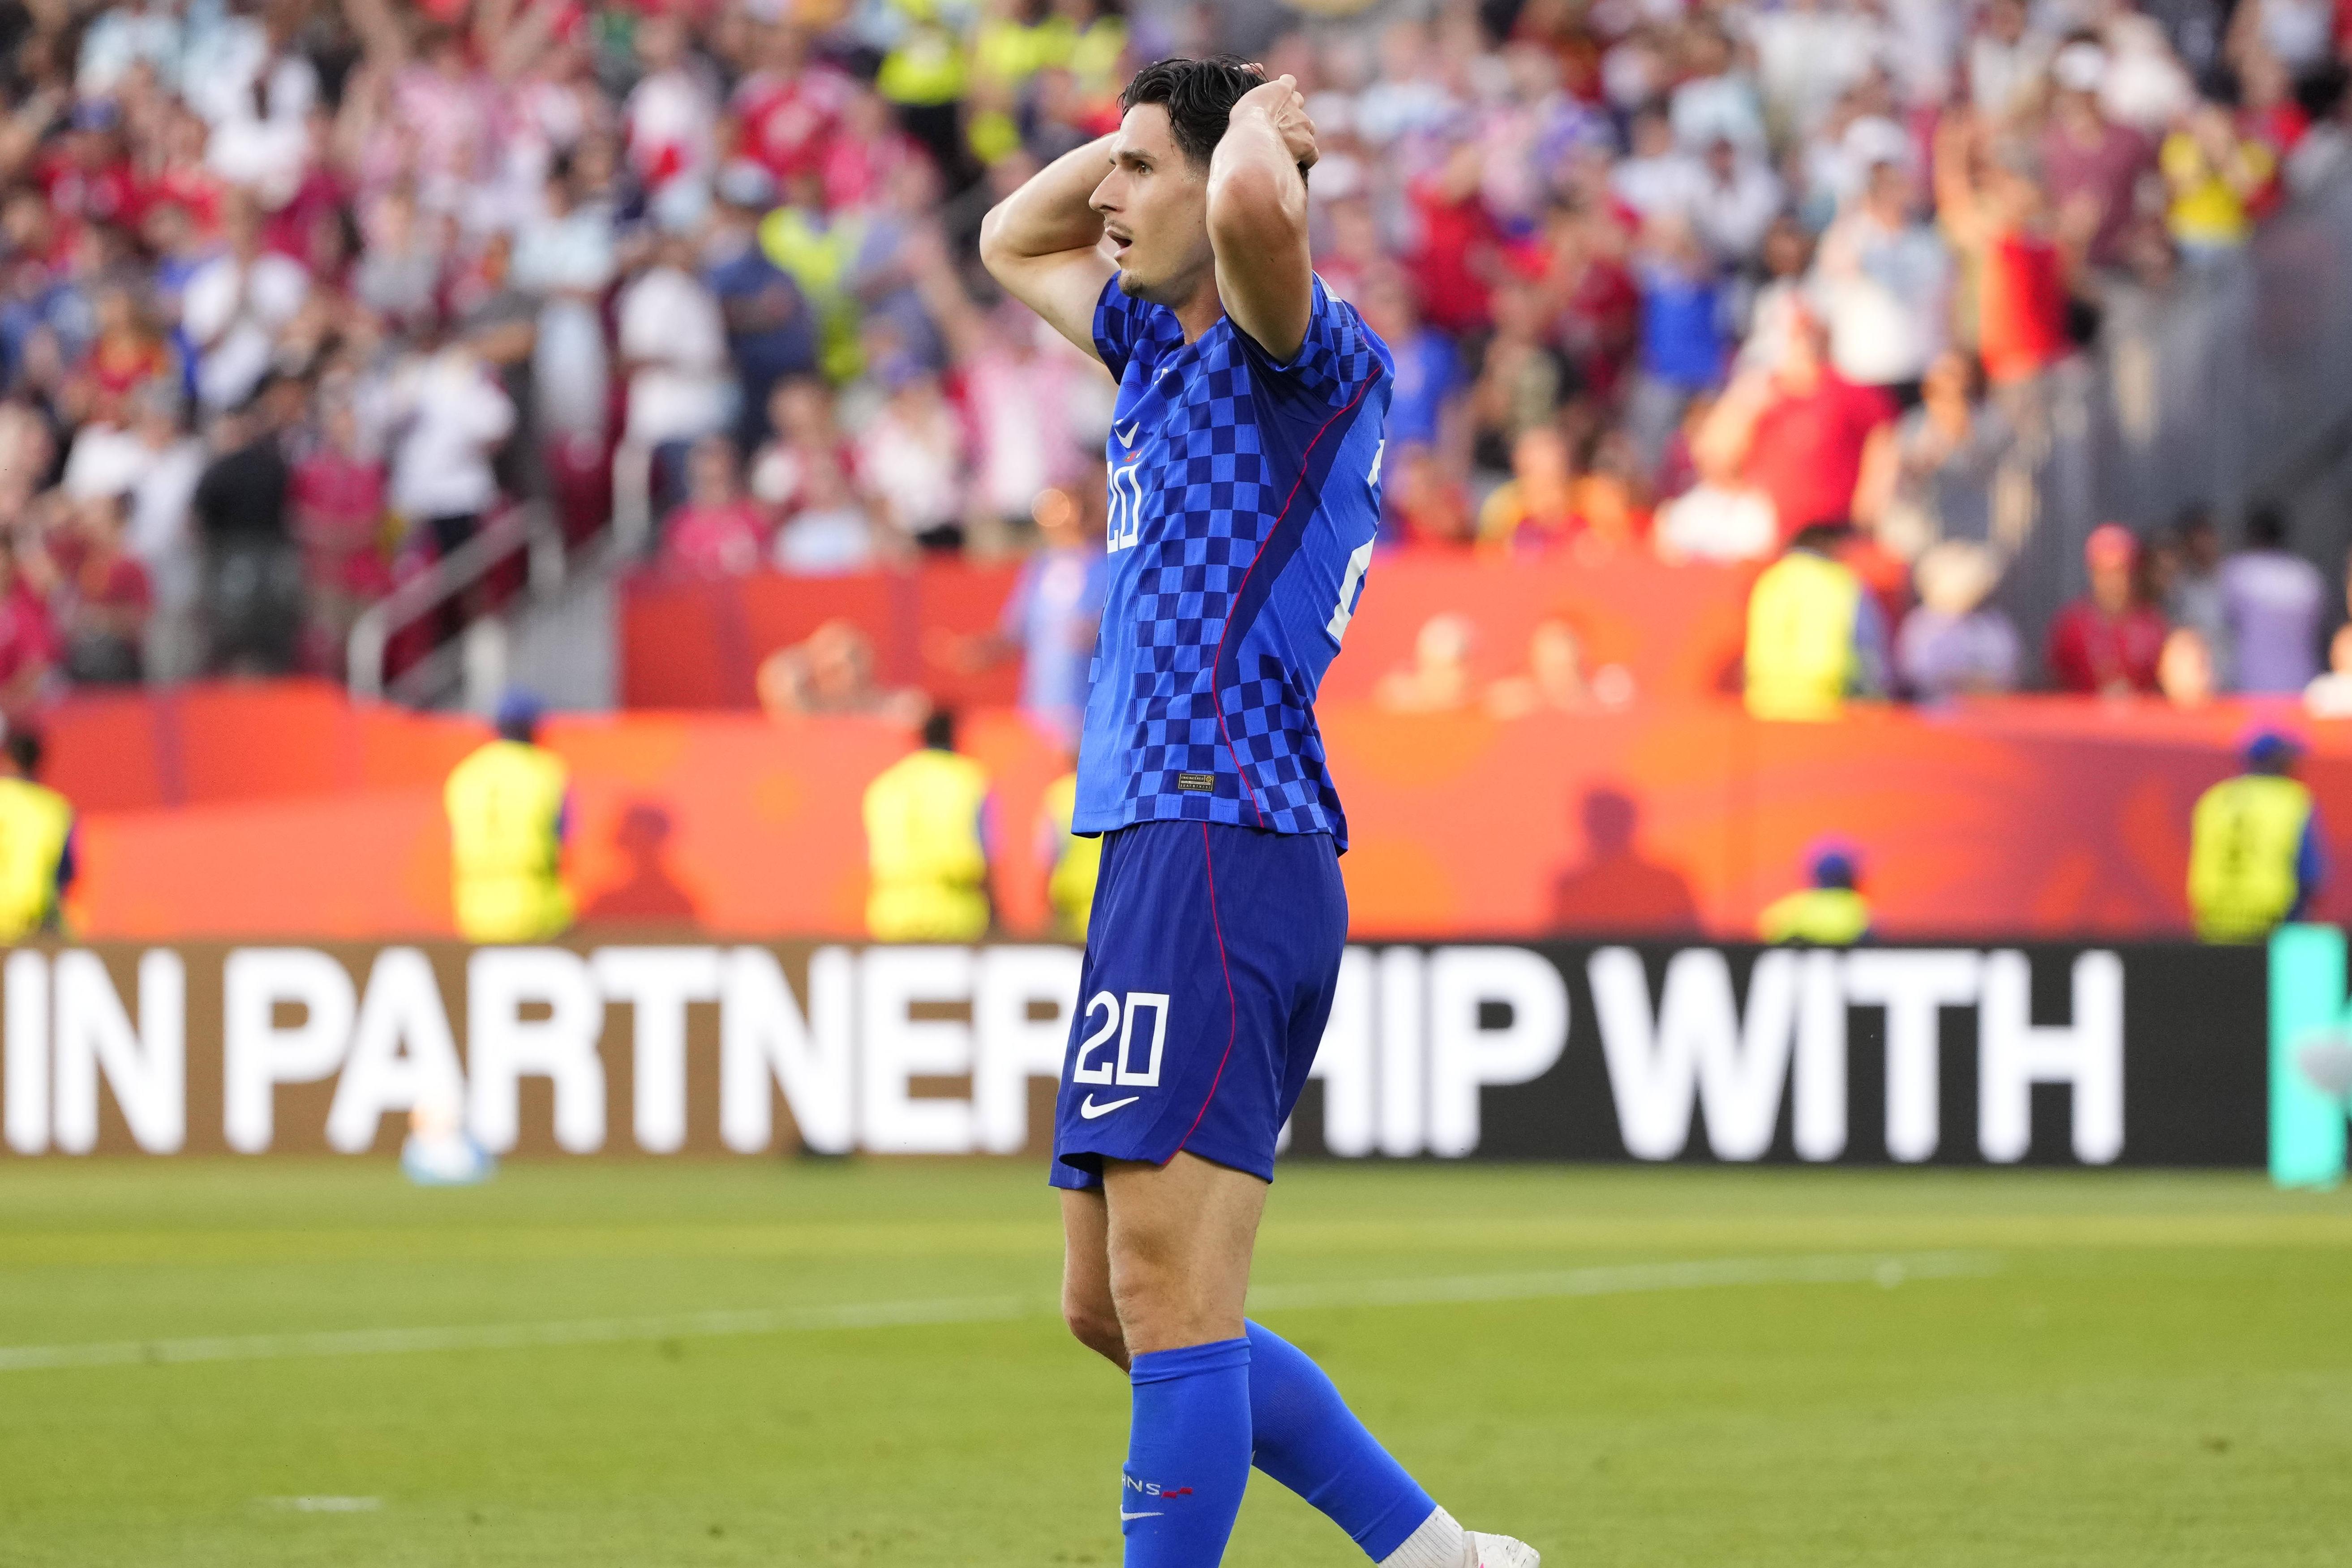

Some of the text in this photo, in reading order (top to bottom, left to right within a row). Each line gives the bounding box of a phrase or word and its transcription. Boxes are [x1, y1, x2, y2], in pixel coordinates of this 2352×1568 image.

[4, 946, 186, 1156] IN
[222, 945, 1570, 1159] PARTNERHIP
[1585, 944, 2125, 1164] WITH
[1073, 990, 1170, 1087] 20
